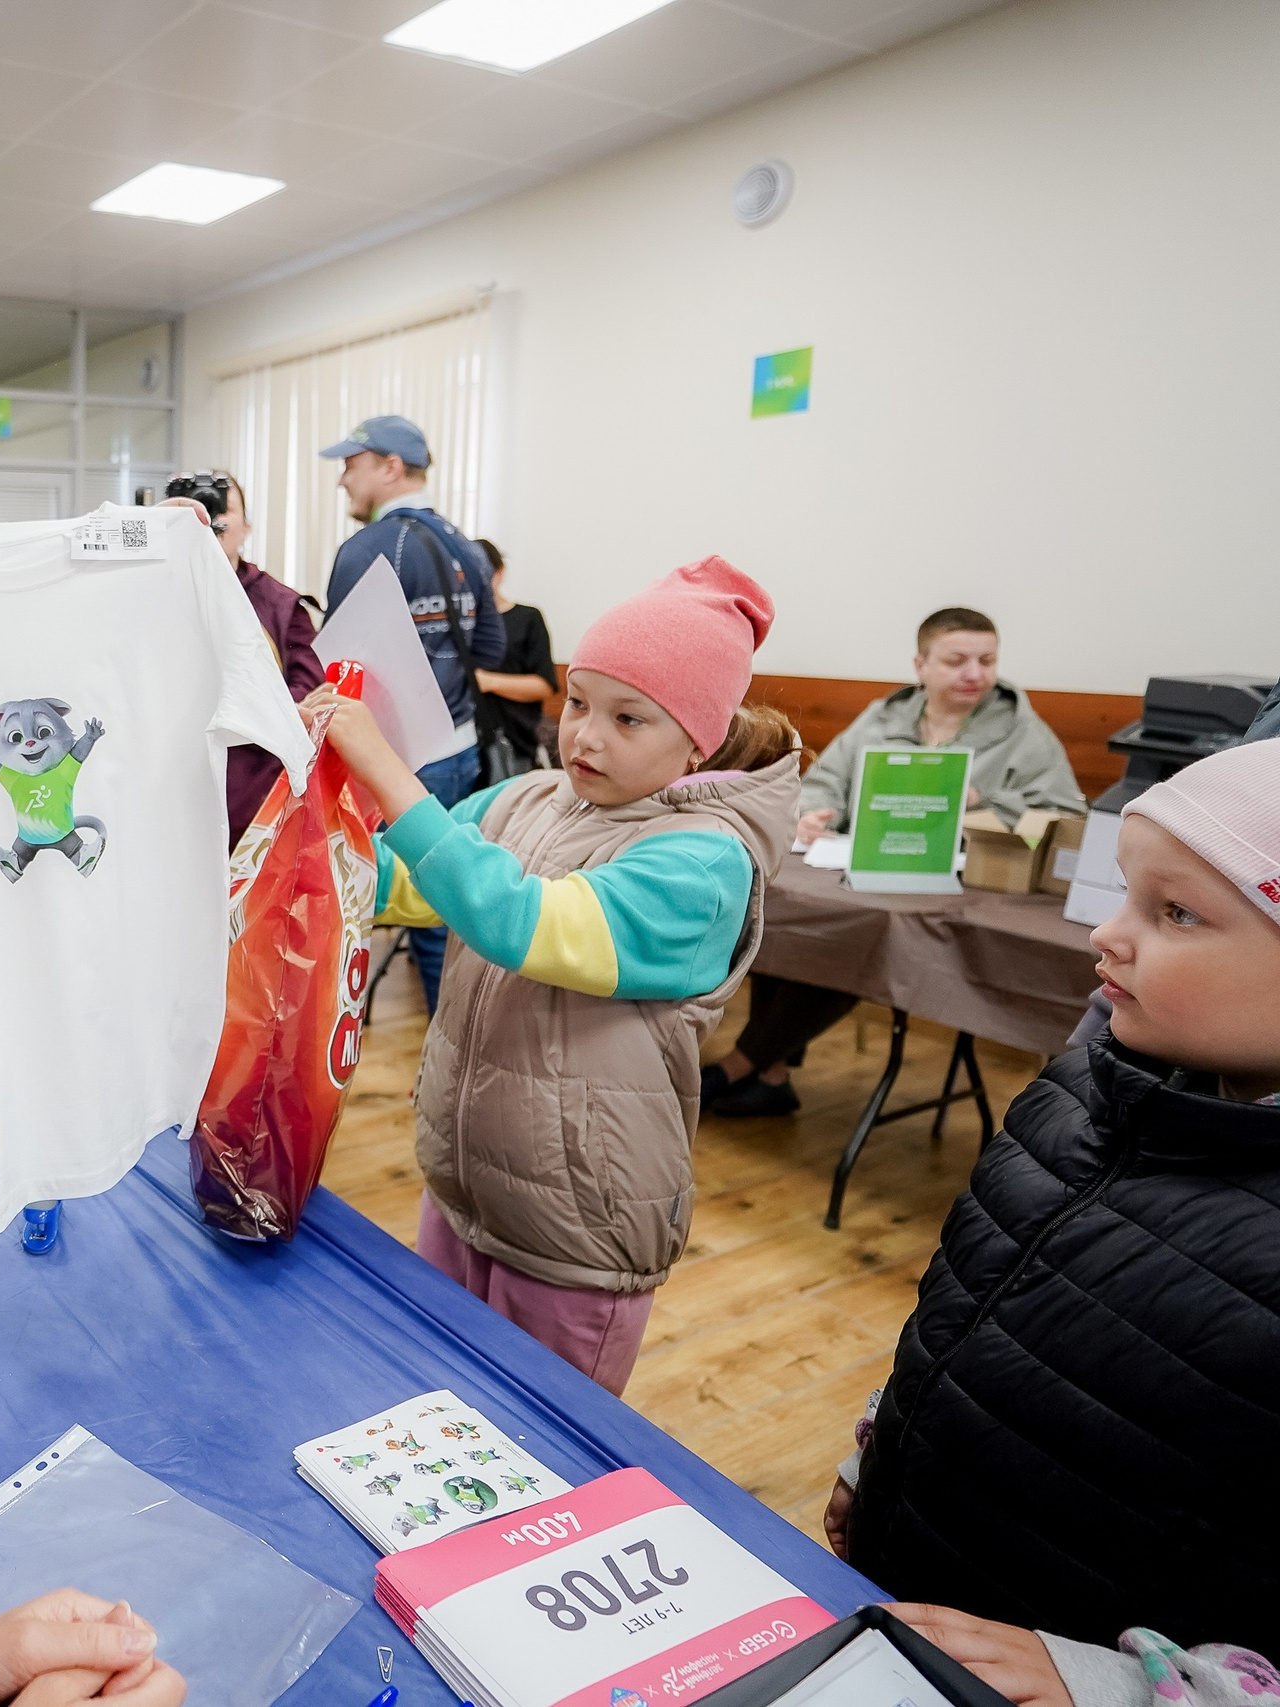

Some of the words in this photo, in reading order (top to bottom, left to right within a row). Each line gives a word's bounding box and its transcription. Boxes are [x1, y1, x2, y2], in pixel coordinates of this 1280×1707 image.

[500, 1510, 582, 1547] 400м
[525, 1538, 689, 1631] 2708
[655, 1601, 684, 1619] 7-9
[622, 1613, 655, 1635] ЛЕТ
[738, 1630, 778, 1656] СБЕР
[678, 1652, 720, 1676] марафон
[683, 1663, 724, 1689] зелёный
